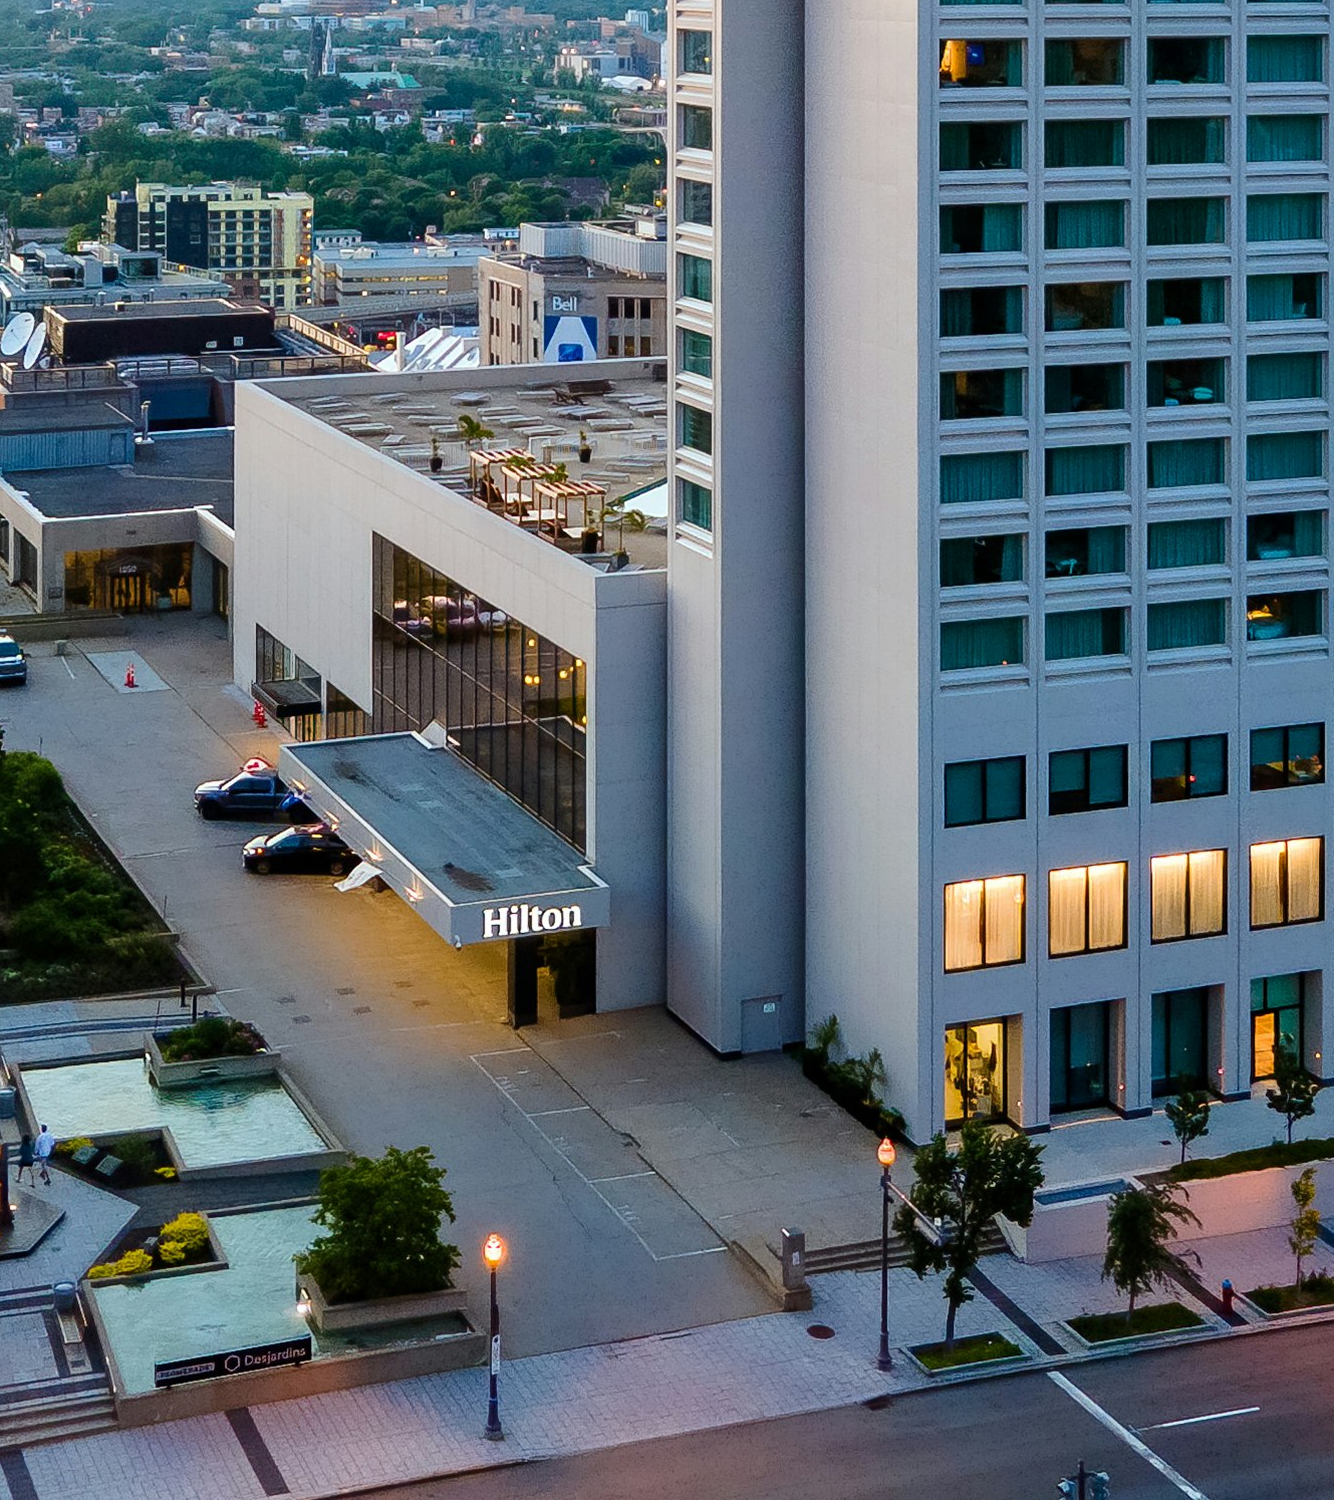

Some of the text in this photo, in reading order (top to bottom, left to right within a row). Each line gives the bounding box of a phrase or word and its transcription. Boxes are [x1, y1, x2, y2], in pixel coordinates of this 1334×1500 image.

[552, 296, 578, 312] Bell
[482, 903, 582, 939] Hilton
[244, 1346, 307, 1367] Desjardins
